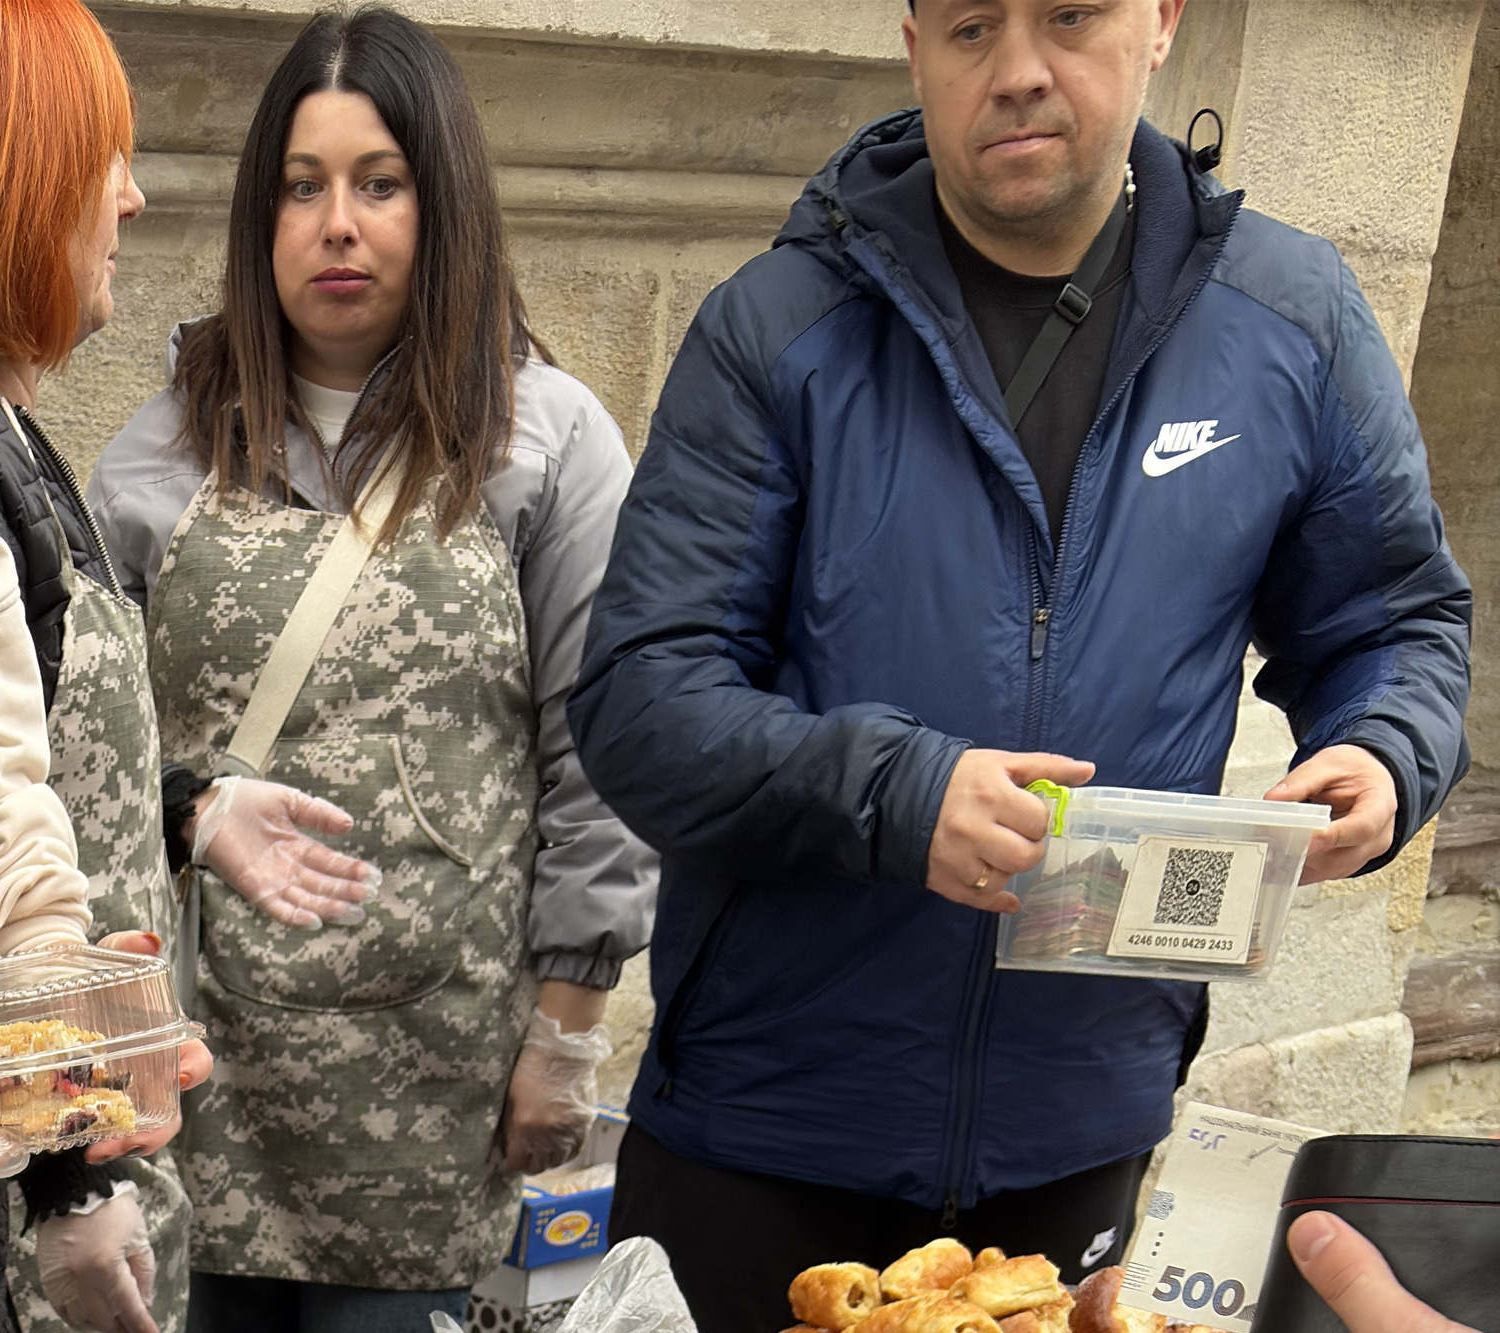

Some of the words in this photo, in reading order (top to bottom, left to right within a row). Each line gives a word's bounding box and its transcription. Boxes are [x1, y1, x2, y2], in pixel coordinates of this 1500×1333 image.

[1154, 419, 1219, 453] NIKE
[1128, 935, 1153, 946] 4246
[1155, 935, 1179, 948] 0010
[1182, 937, 1206, 949] 0429
[1208, 938, 1233, 951] 2433
[1152, 1265, 1245, 1317] 500
